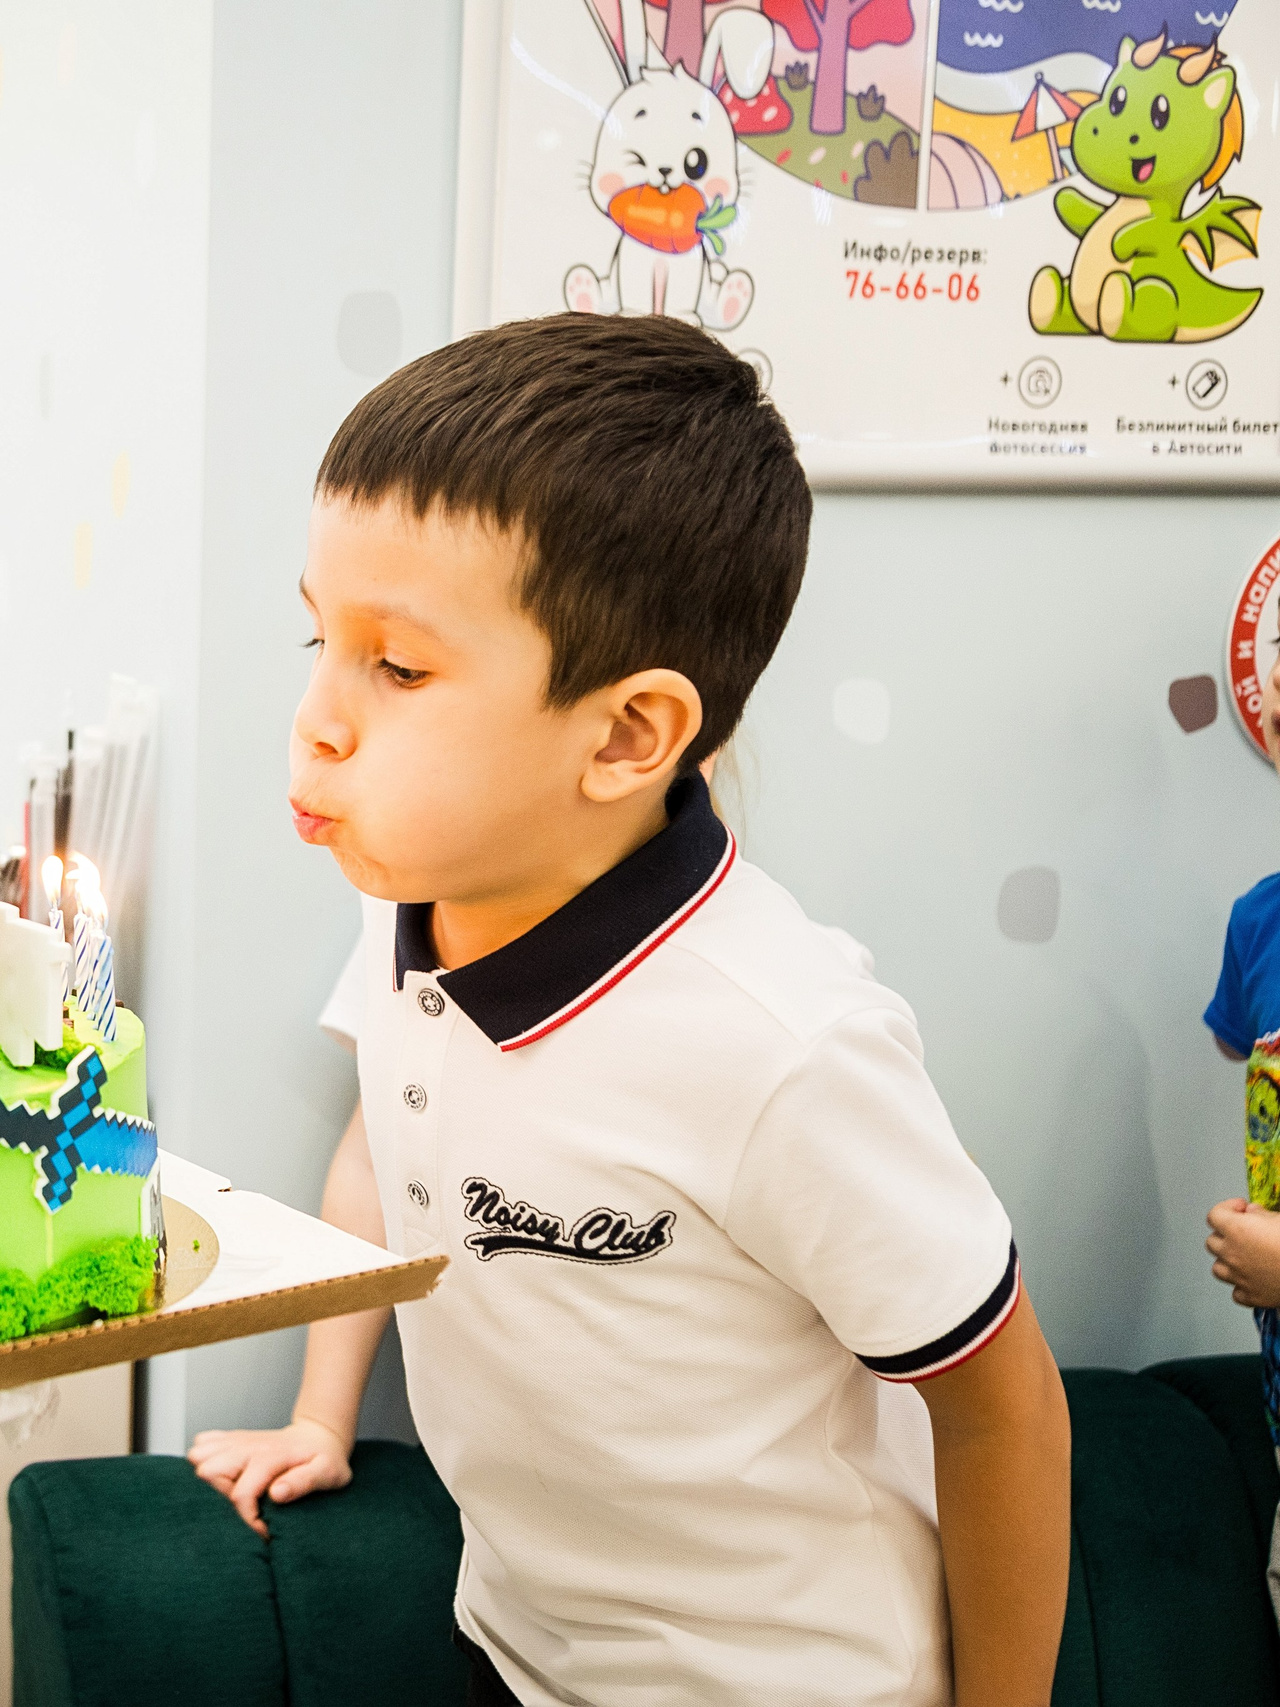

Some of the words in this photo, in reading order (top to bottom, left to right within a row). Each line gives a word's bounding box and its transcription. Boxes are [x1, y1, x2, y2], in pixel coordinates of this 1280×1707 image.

[843, 239, 988, 268] Инфо/резерв:
[845, 270, 981, 302] 76-66-06
[1116, 416, 1228, 434] Безлимитный
[1232, 417, 1280, 434] билет
[1167, 441, 1244, 455] Автосити
[465, 1181, 562, 1244] Noisy
[574, 1213, 671, 1253] Club
